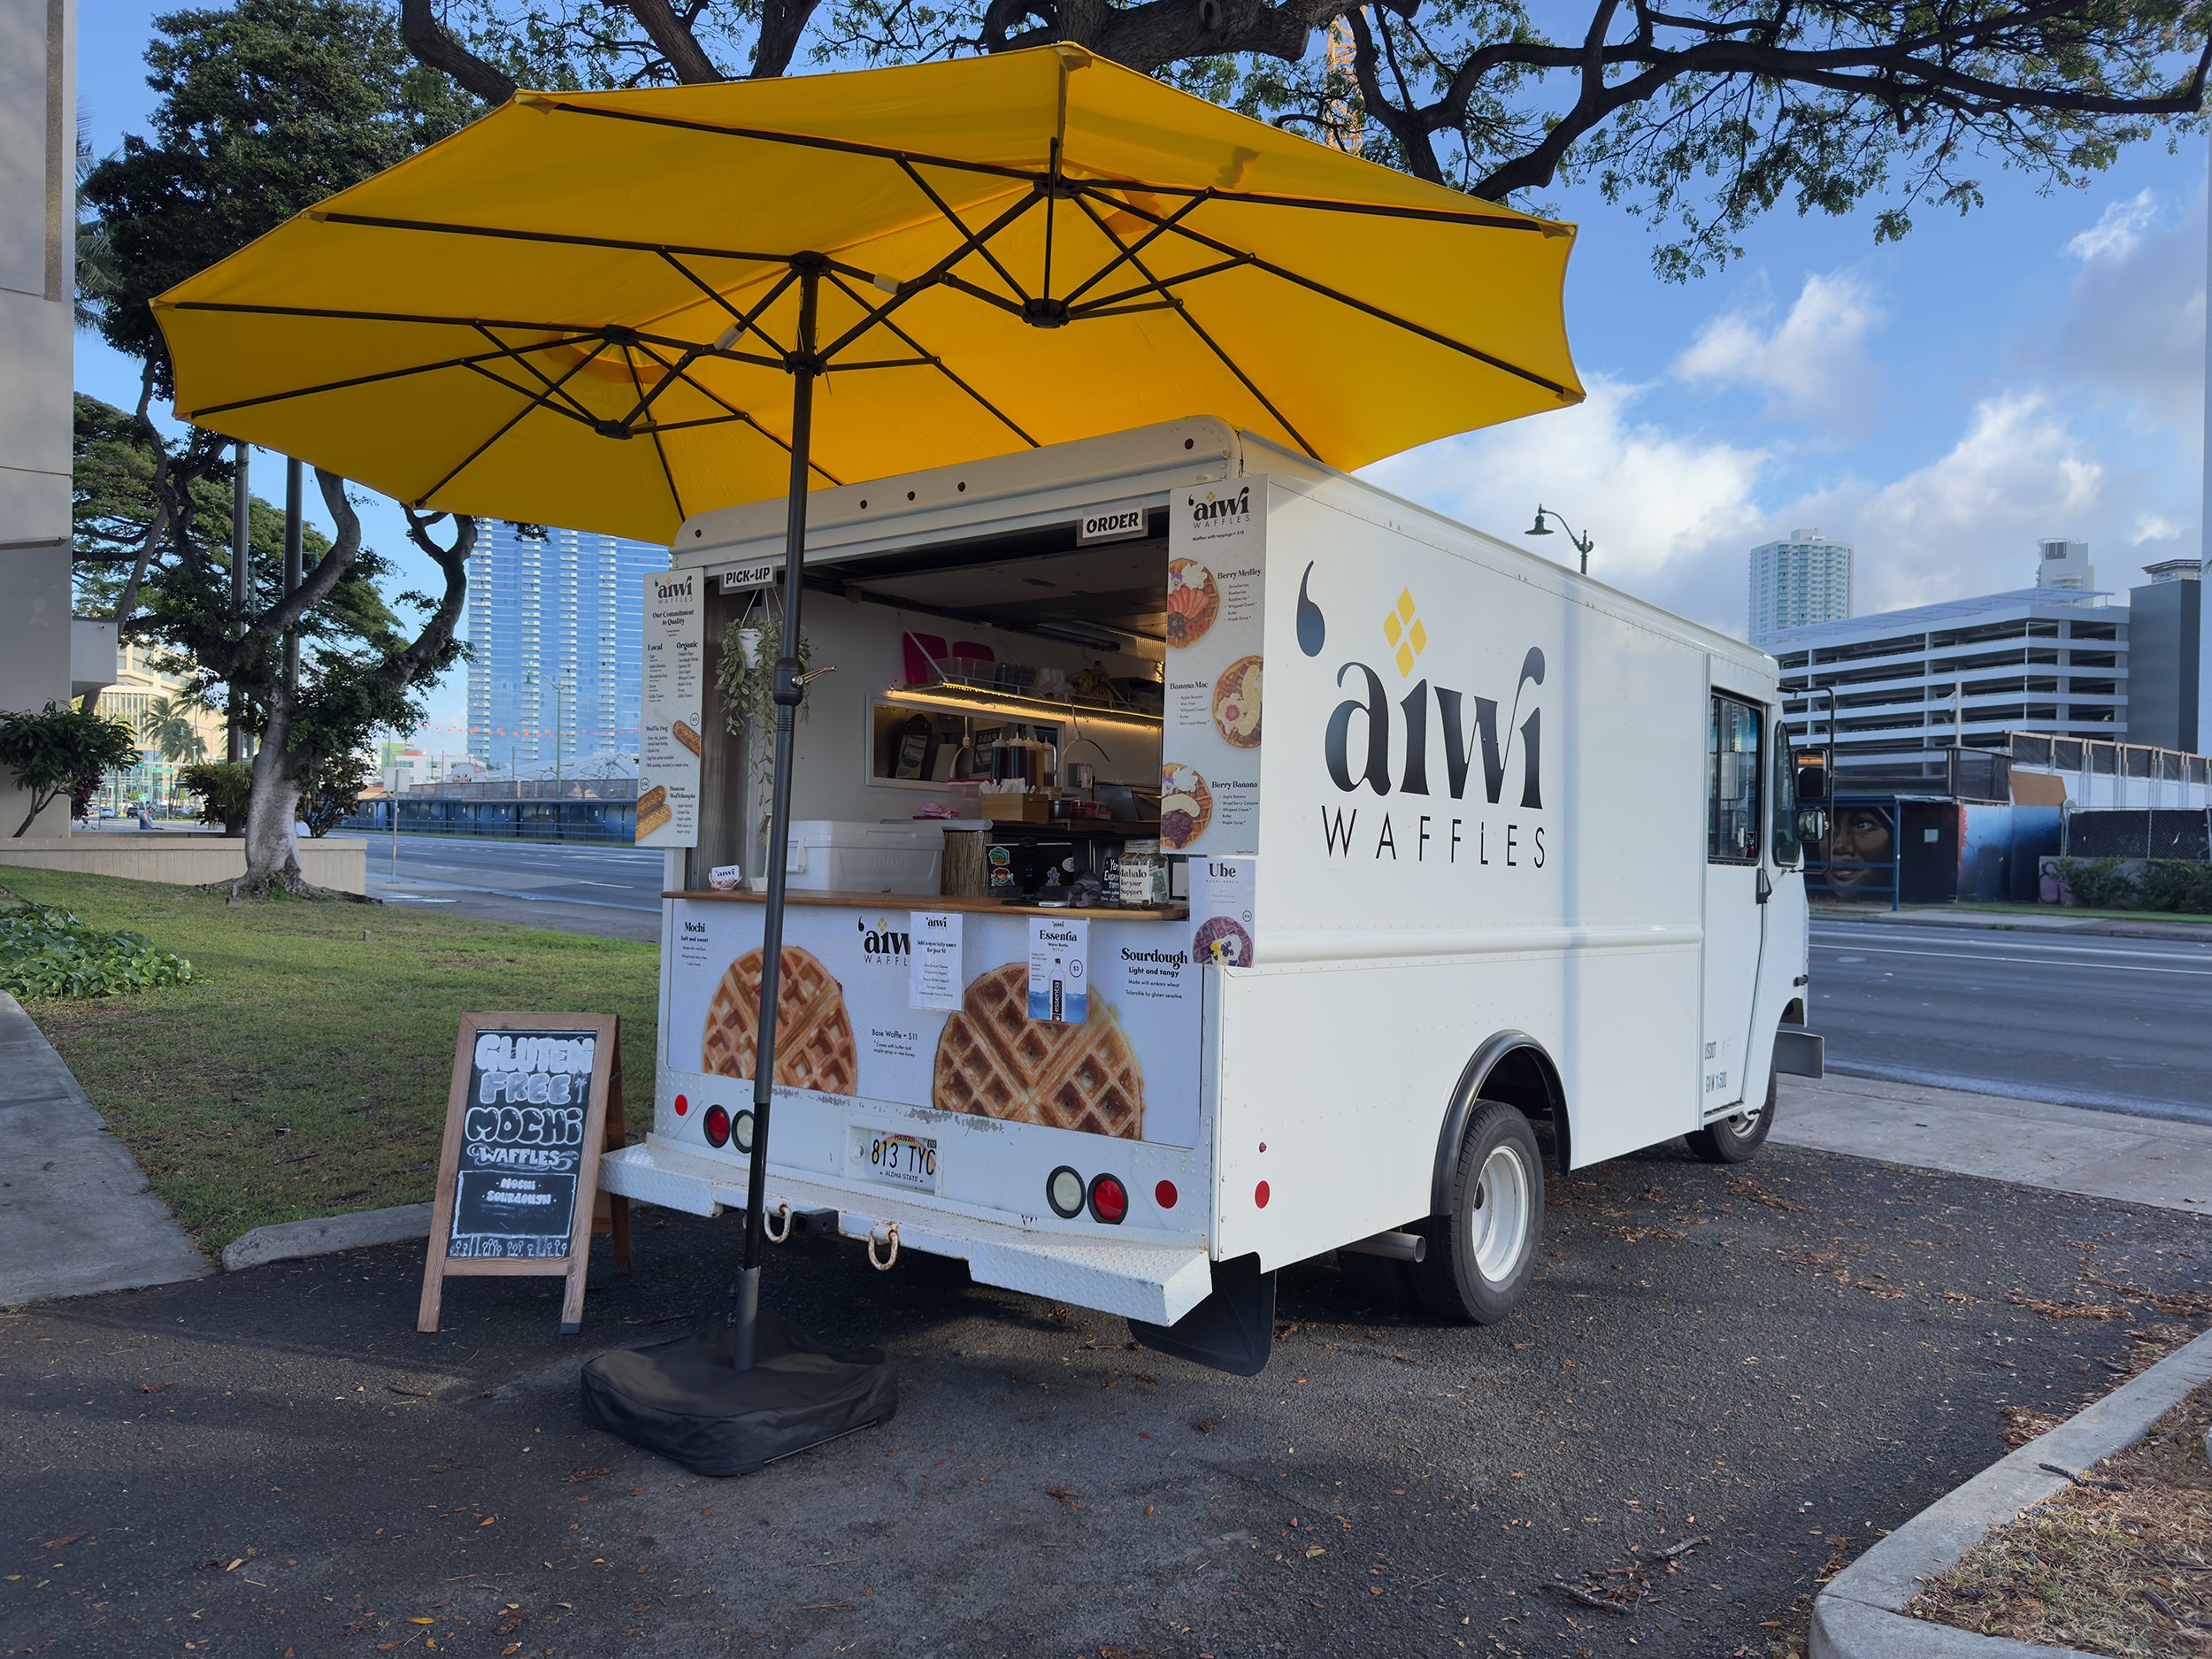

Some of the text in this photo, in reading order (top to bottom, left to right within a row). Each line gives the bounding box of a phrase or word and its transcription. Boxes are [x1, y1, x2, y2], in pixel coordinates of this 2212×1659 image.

[1087, 512, 1139, 534] ORDER
[1194, 515, 1250, 529] WAFFLES
[726, 567, 771, 584] PICK-UP
[1238, 568, 1261, 576] Medley
[658, 595, 693, 604] WAFFLES
[663, 609, 694, 618] Commitment
[668, 618, 685, 626] Quality
[676, 641, 698, 651] Organic
[1212, 781, 1232, 790] Berry
[1321, 805, 1545, 869] WAFFLES
[1209, 862, 1237, 878] Ube
[685, 922, 705, 933] Mochi
[858, 916, 910, 955] 'aiw
[1039, 929, 1077, 942] Essentia
[864, 955, 908, 967] WAFFL
[1121, 947, 1188, 970] Sourdough
[1129, 967, 1144, 975] Light
[1160, 969, 1179, 978] tangy
[885, 1030, 902, 1039] Waffle
[474, 1033, 595, 1074] GLUTEN
[479, 1071, 572, 1105] FREE
[479, 1146, 560, 1166] WAFFLES
[872, 1139, 936, 1176] 813 TYC
[885, 1170, 918, 1183] ALOHA STATE
